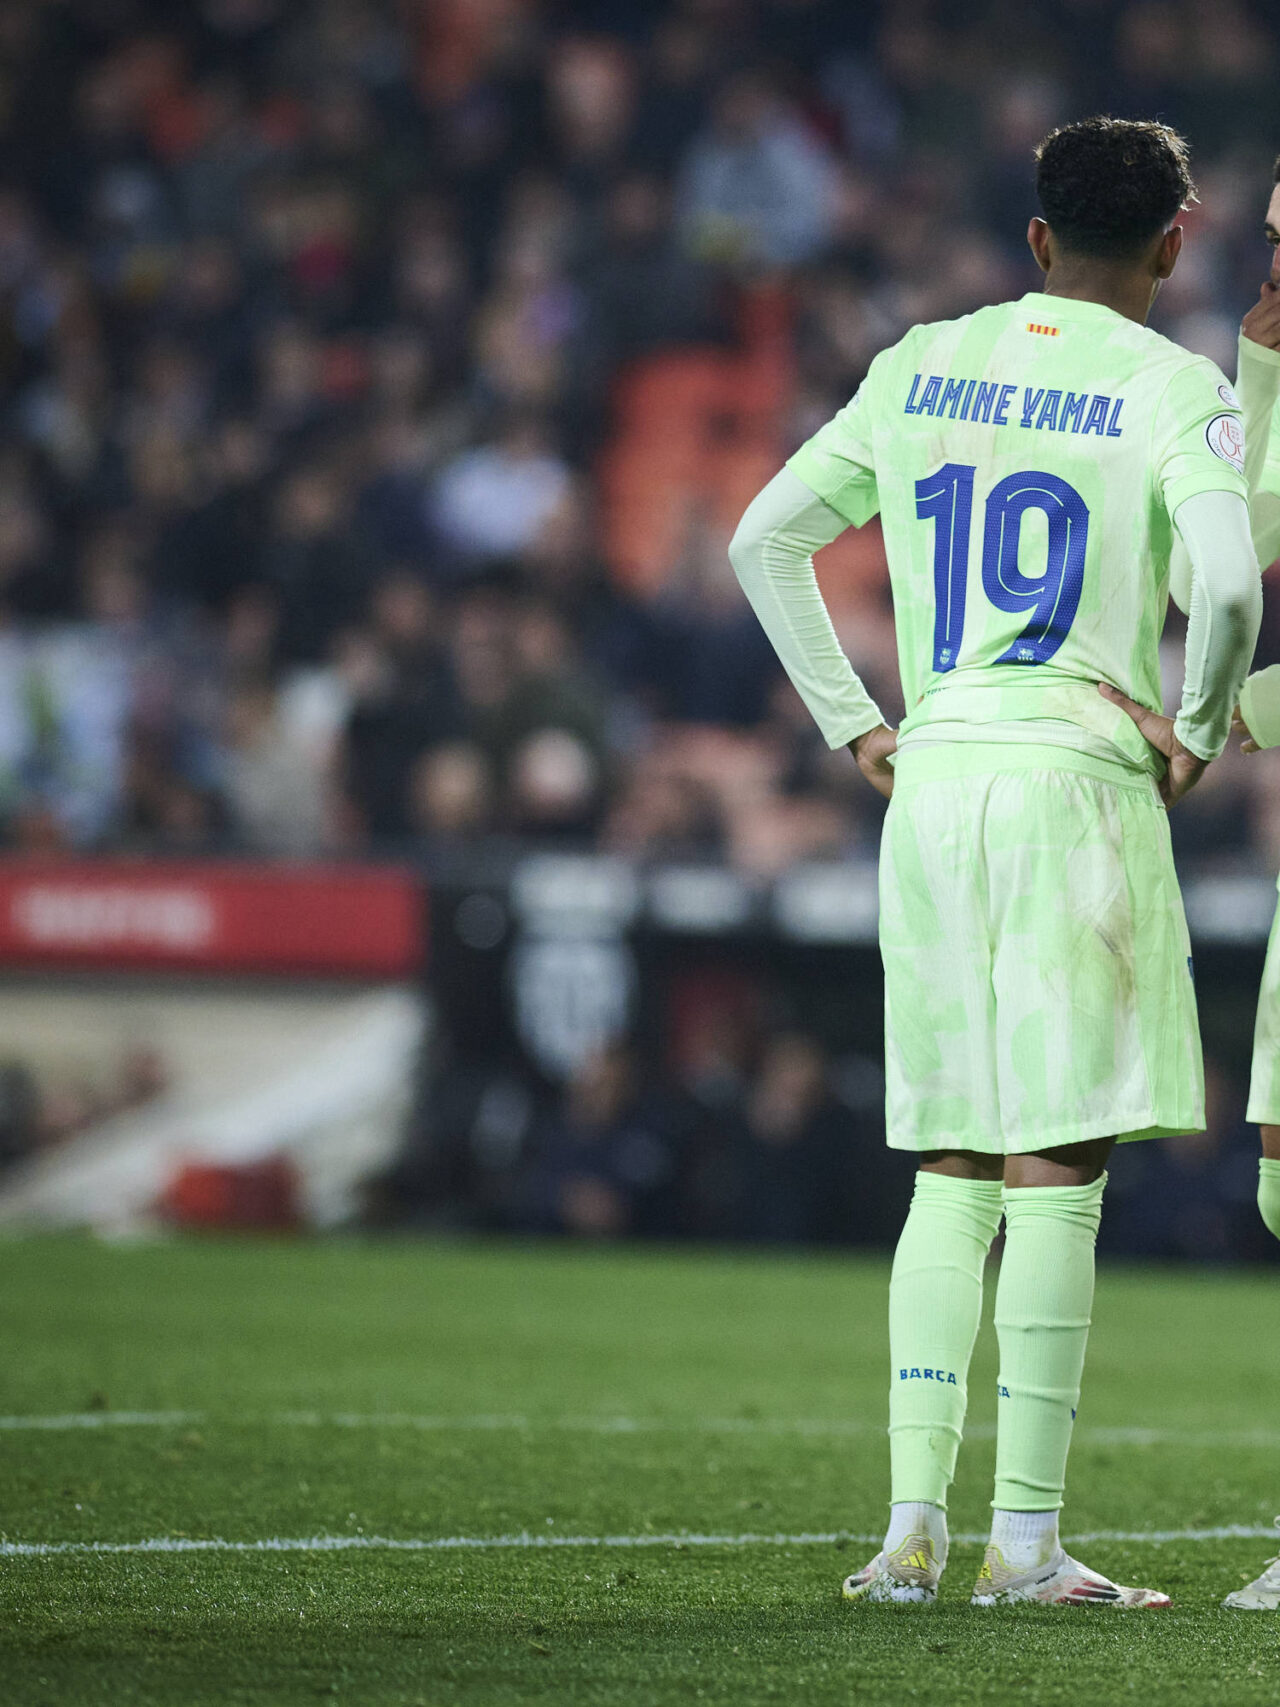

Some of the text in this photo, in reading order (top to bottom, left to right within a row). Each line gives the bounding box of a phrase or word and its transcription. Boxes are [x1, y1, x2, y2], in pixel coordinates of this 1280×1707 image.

[904, 373, 1125, 437] LAMINE YAMAL
[915, 463, 1090, 673] 19
[900, 1368, 957, 1385] BARÇA
